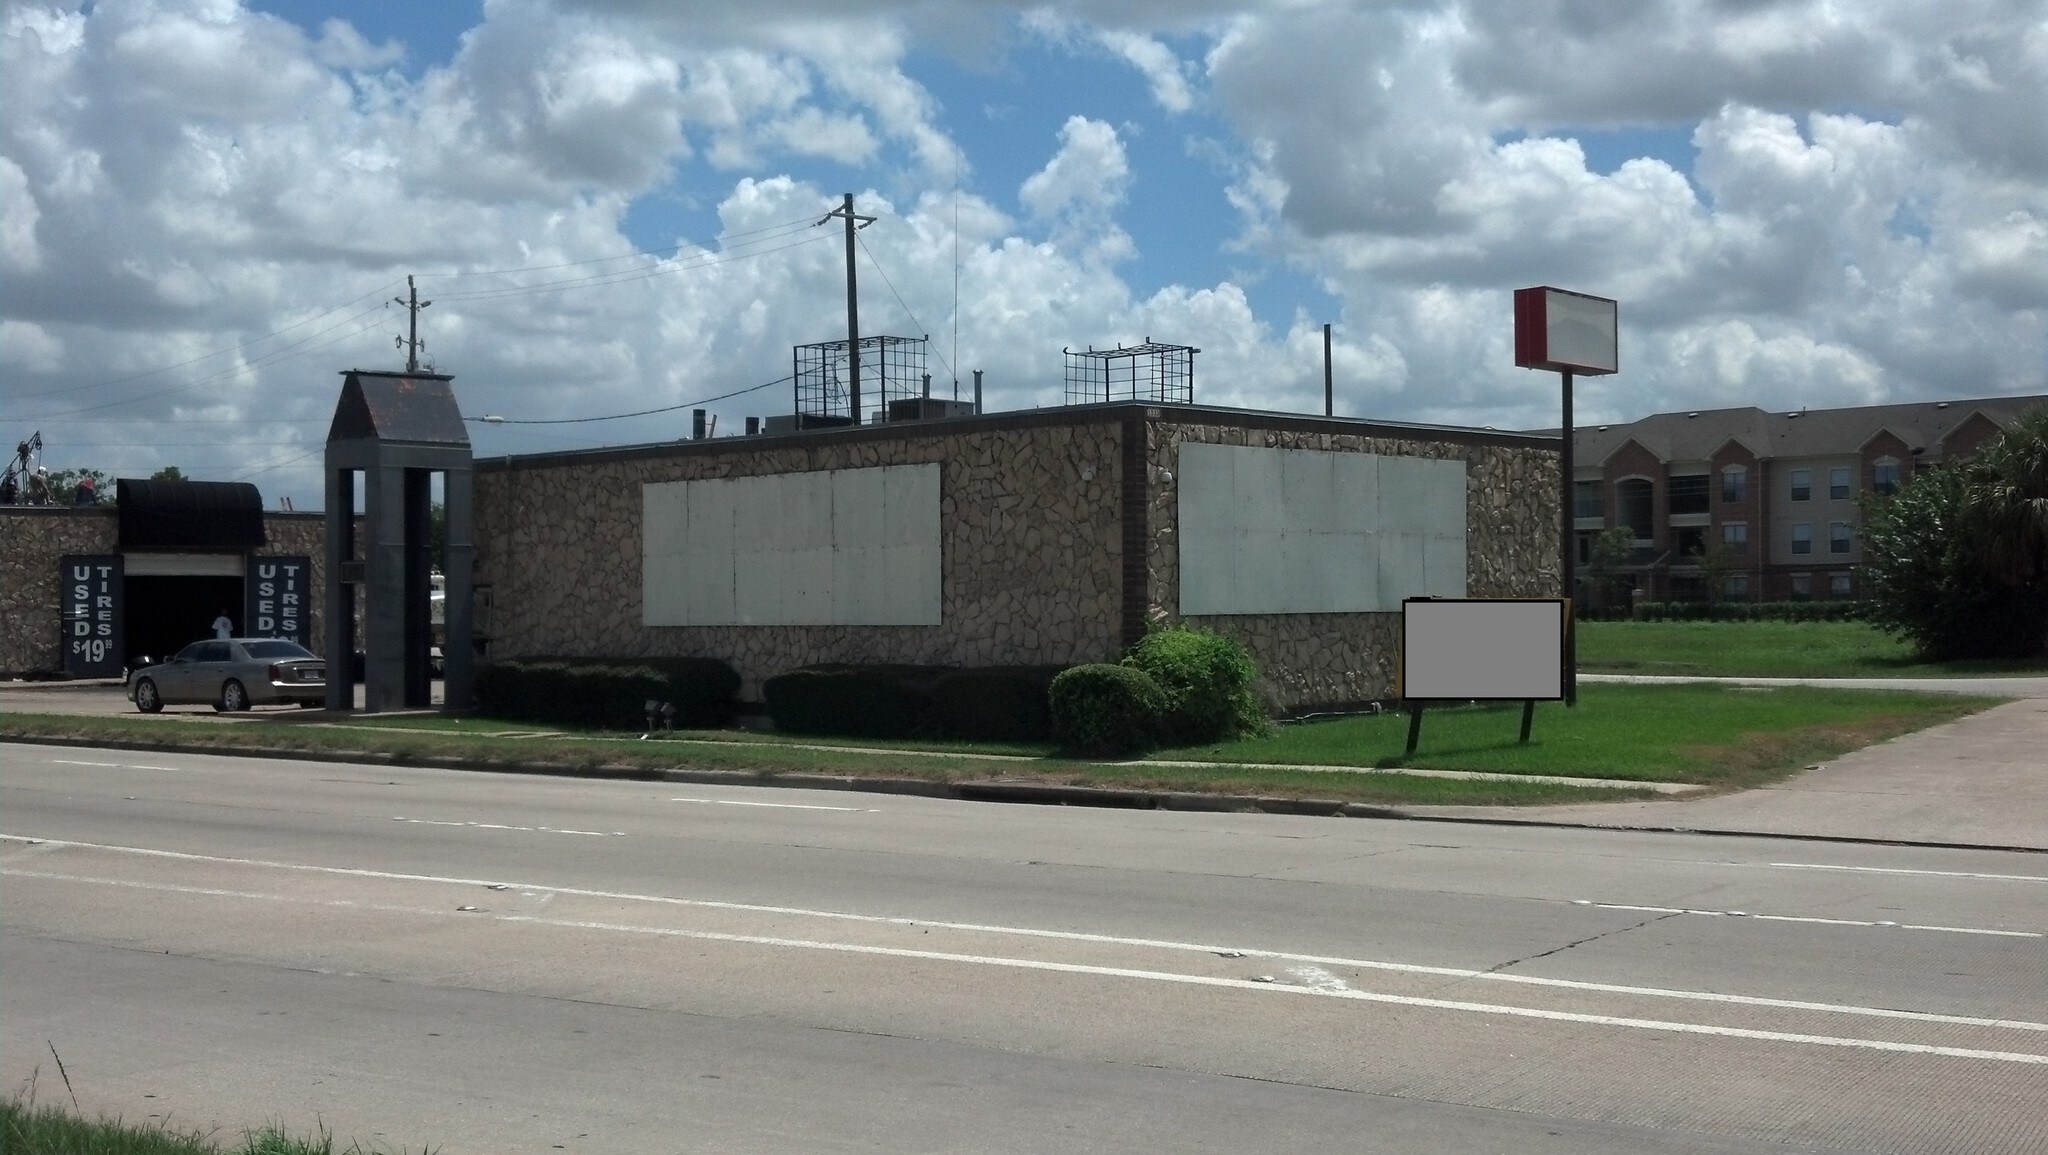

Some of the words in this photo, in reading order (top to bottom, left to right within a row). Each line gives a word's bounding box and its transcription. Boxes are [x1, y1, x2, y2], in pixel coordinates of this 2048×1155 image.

[74, 566, 90, 636] USED
[97, 567, 112, 635] TIRES
[258, 565, 276, 630] USED
[282, 566, 299, 631] TIRES
